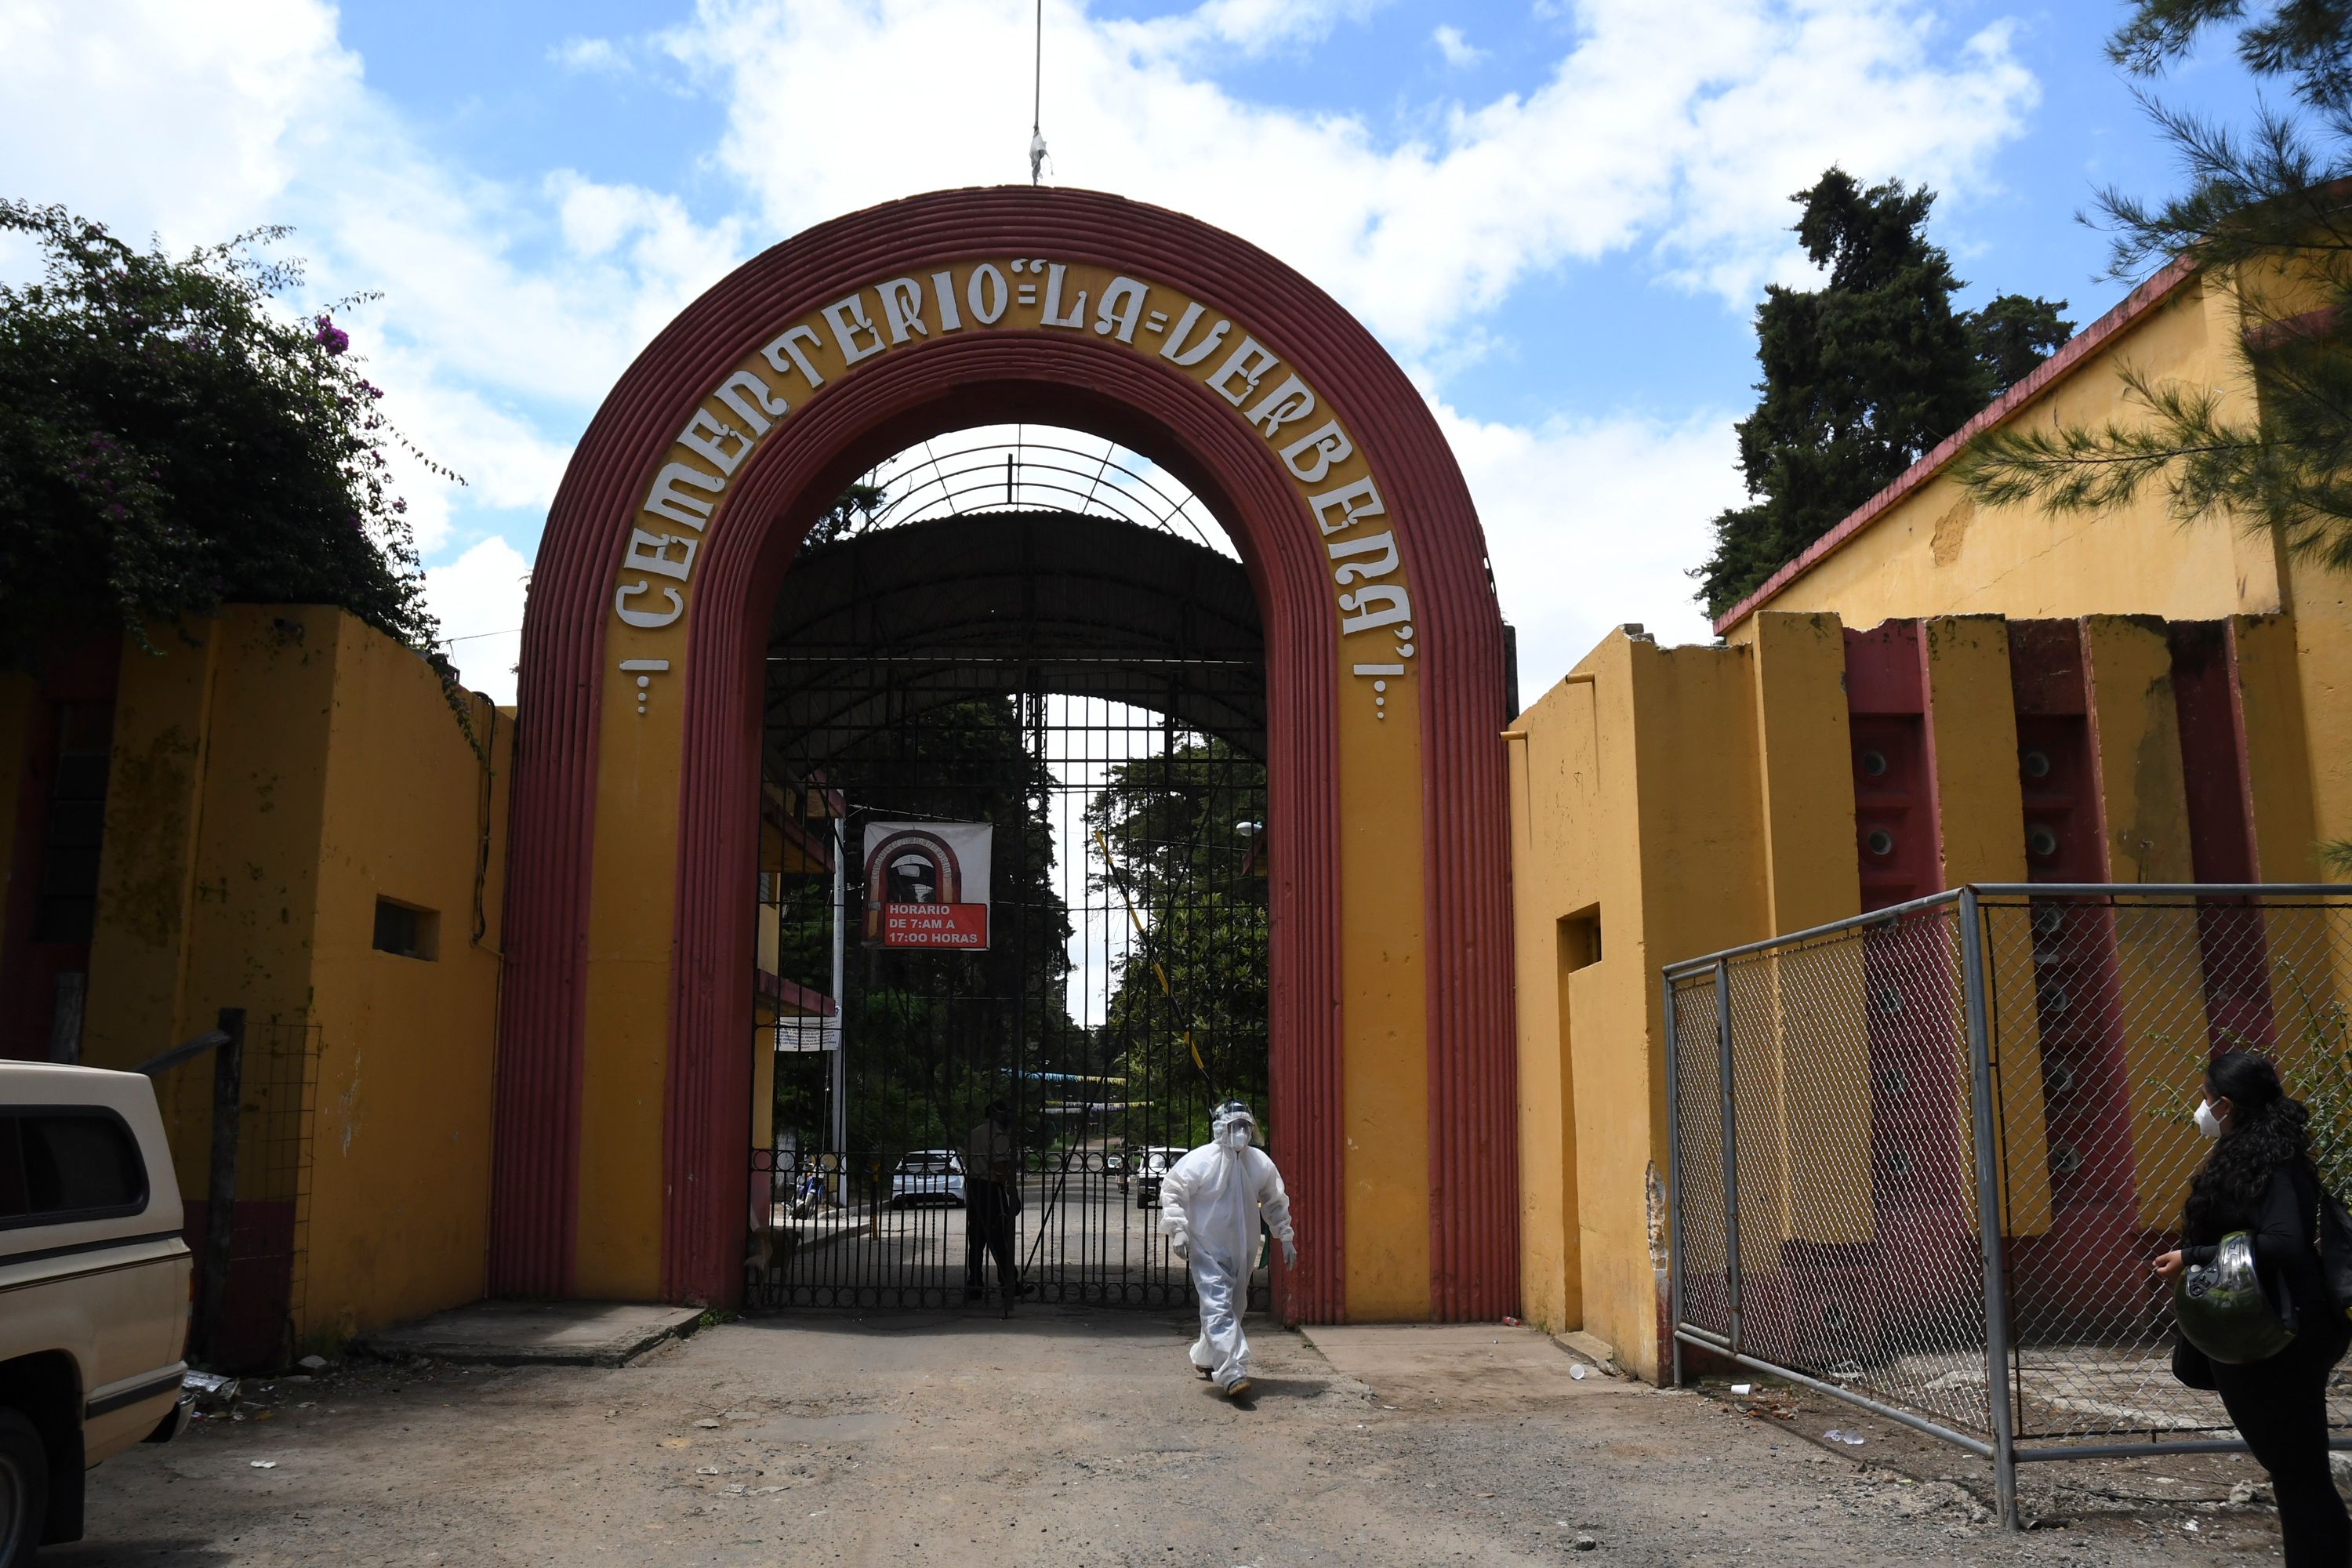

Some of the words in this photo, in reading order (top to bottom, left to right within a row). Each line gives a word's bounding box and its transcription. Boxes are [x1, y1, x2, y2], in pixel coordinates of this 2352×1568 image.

[615, 263, 1008, 628] CEMENTERIO
[889, 904, 950, 915] HORARIO
[889, 918, 906, 928] DE
[910, 919, 942, 929] 7:AM
[946, 920, 956, 929] A
[931, 933, 978, 943] HORAS
